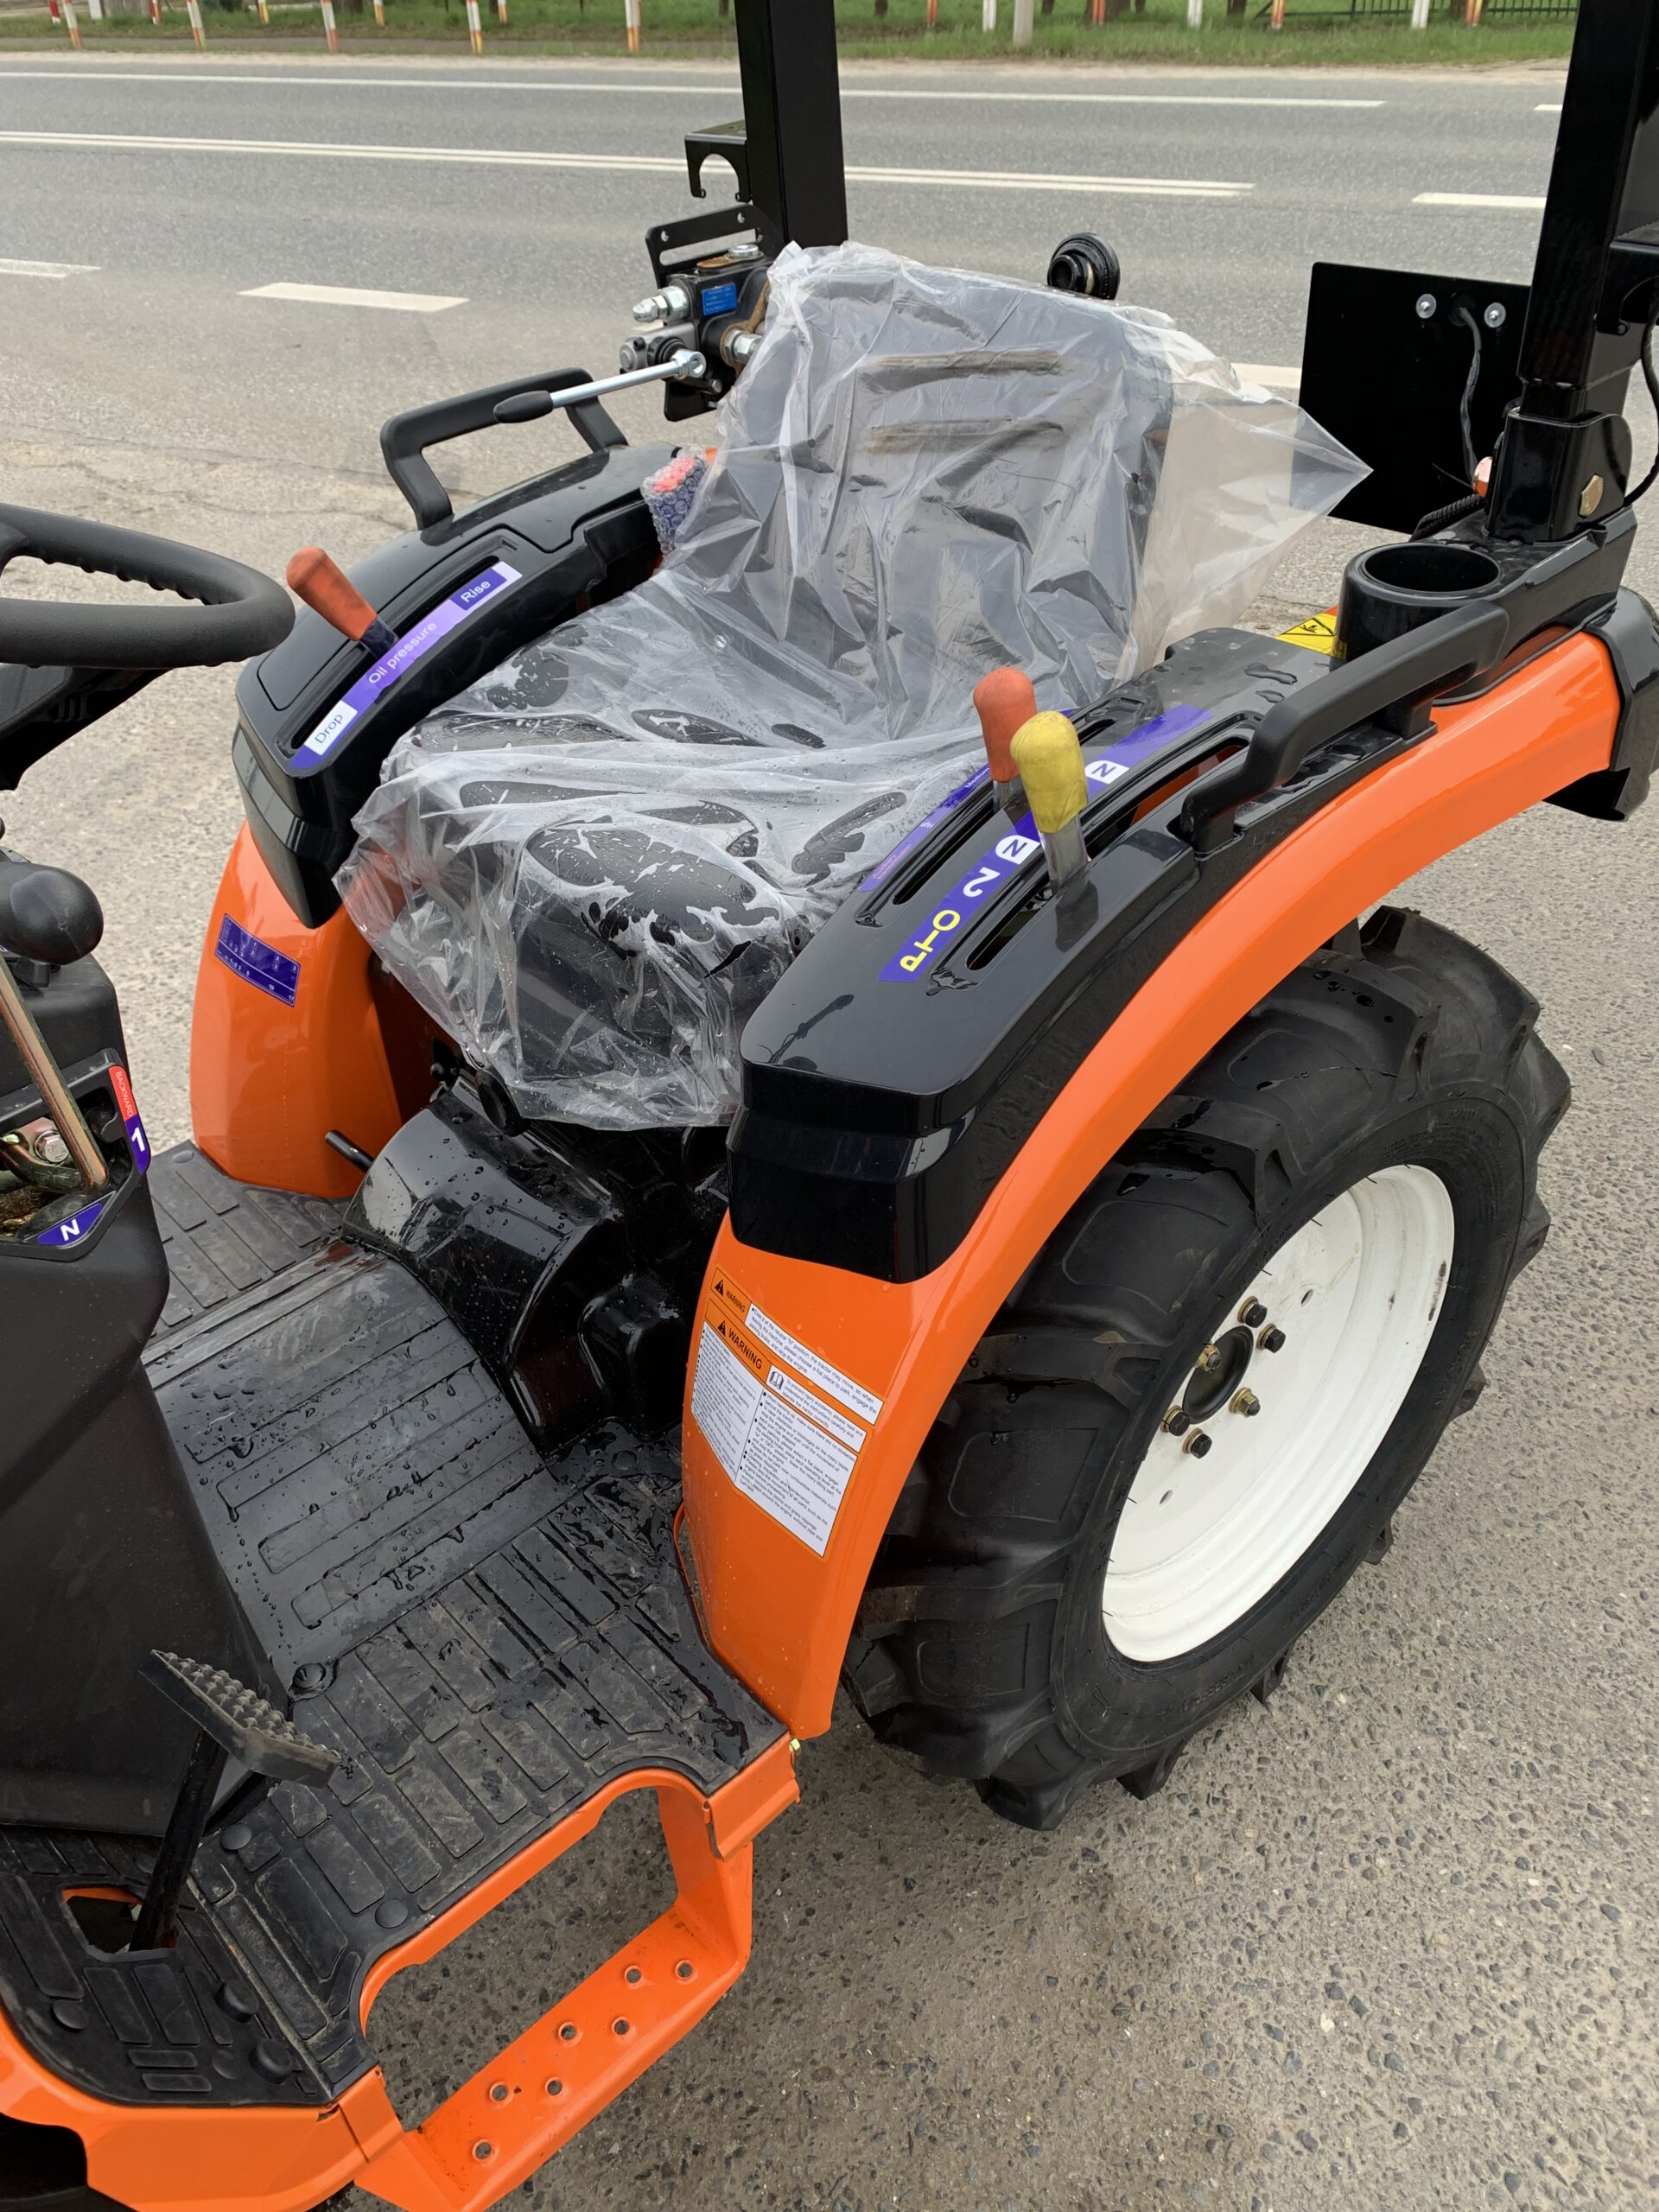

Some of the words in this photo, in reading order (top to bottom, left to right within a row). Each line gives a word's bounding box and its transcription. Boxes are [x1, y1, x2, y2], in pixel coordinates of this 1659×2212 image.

[460, 581, 491, 603] Rise
[368, 666, 388, 683] Oil
[386, 622, 437, 670] pressure
[315, 714, 343, 744] Drop
[1001, 839, 1027, 857] N
[963, 867, 1001, 898] 2
[899, 909, 961, 972] PTO
[115, 1071, 134, 1117] BACKWARD
[131, 1127, 146, 1152] 1
[60, 1218, 80, 1241] N
[728, 1329, 762, 1370] WARNING
